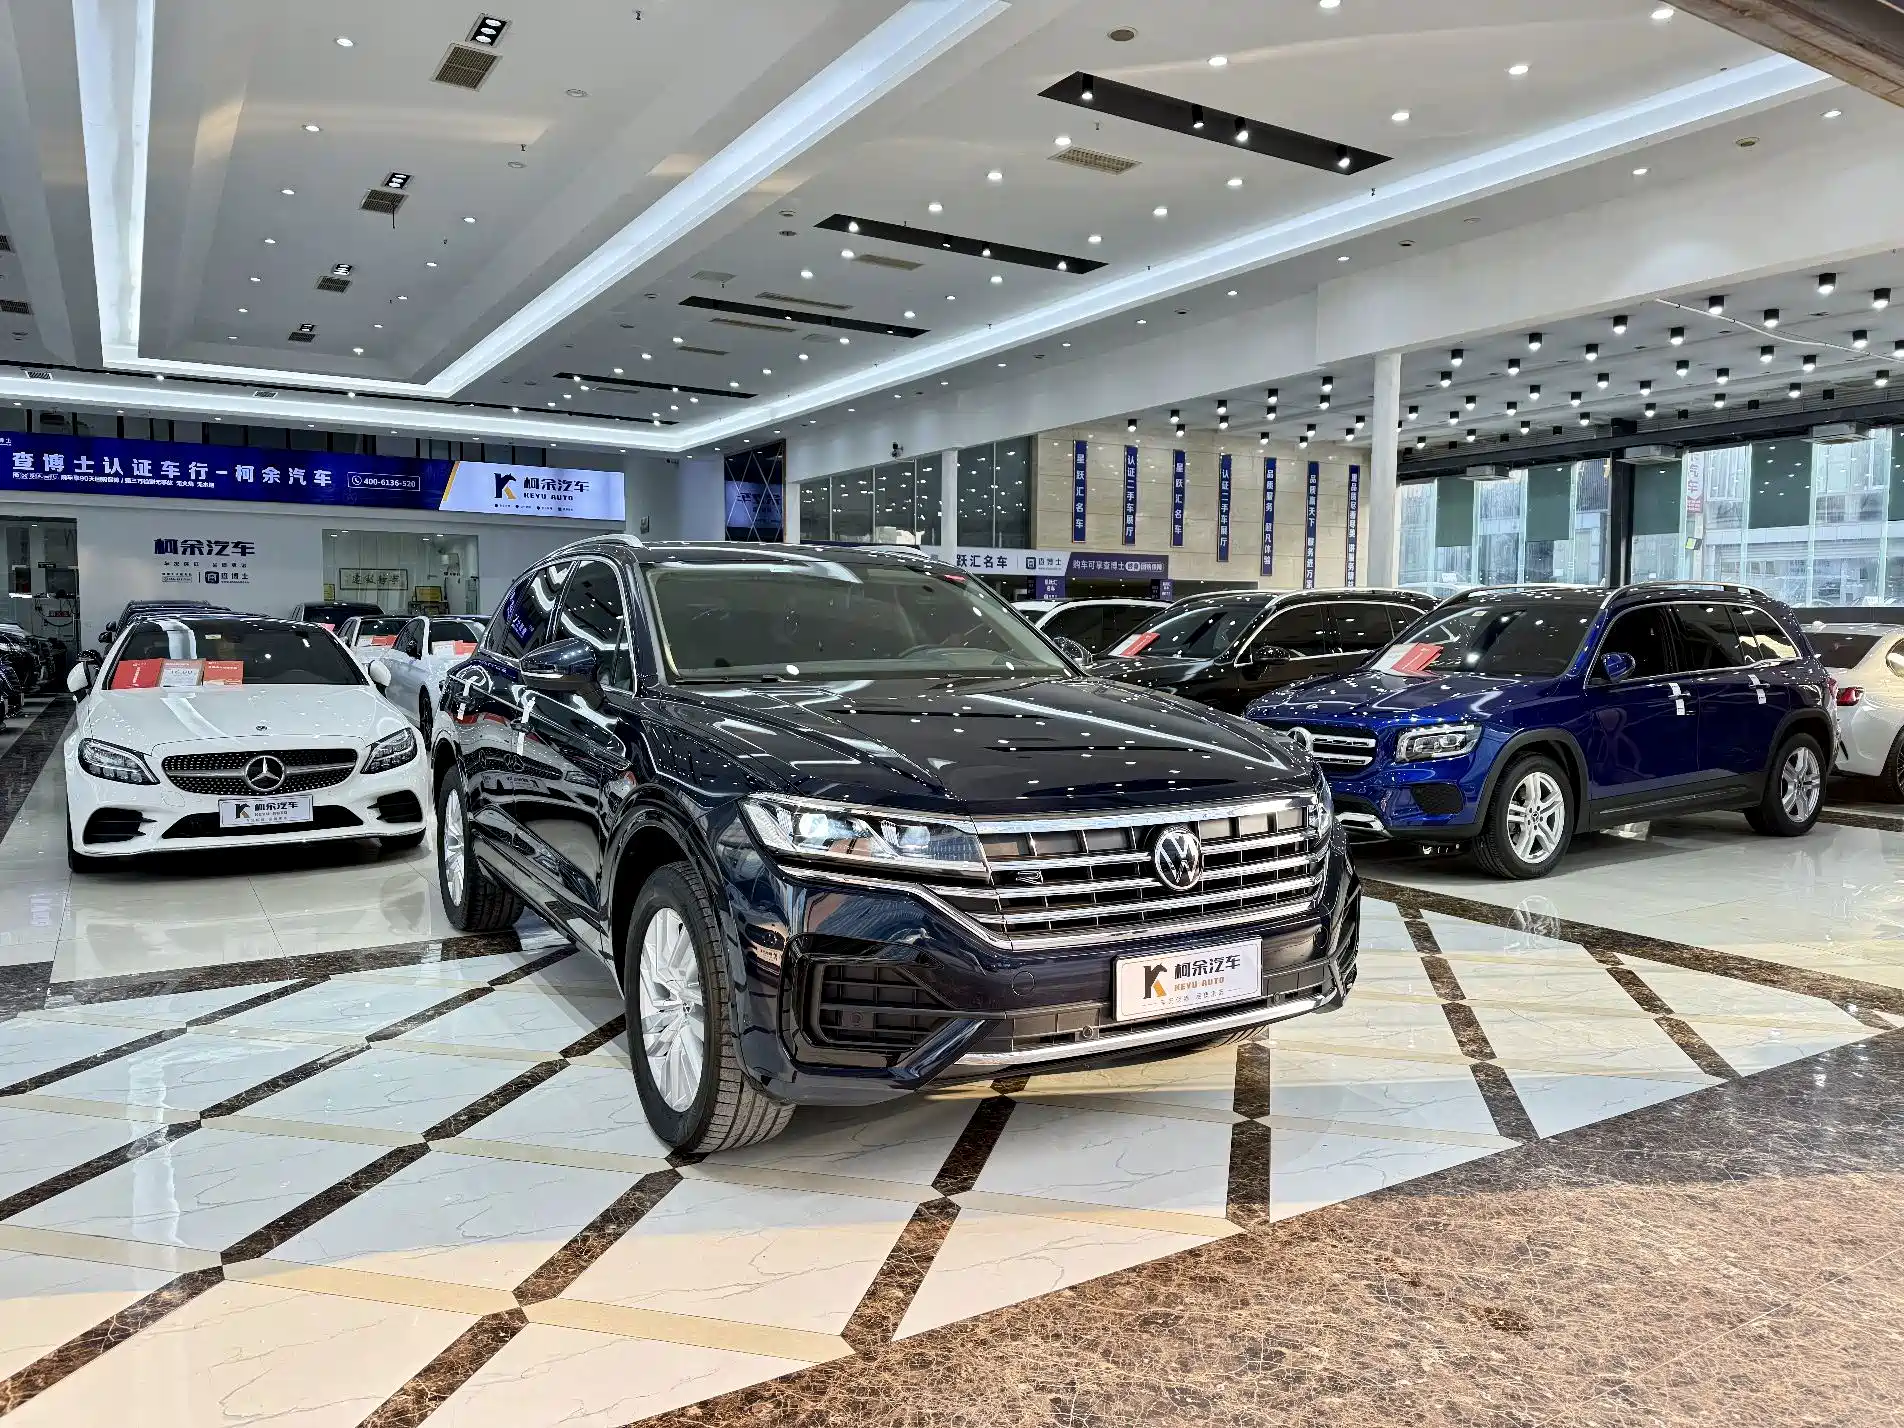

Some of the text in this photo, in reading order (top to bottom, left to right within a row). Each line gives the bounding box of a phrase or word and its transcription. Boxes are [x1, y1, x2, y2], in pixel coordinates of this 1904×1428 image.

[363, 477, 416, 488] 400-6136-520
[523, 476, 590, 493] 柯余汽车
[1075, 453, 1085, 529] 星跃汇名车
[523, 492, 547, 500] KEYU
[1125, 455, 1136, 537] 认证二手车展厅
[1174, 462, 1184, 535] 星跃汇名车
[1219, 469, 1229, 547] 认证二手车展厅
[153, 538, 256, 557] 柯余汽车
[956, 554, 1008, 569] 跃汇名车
[1174, 954, 1241, 980] 柯余汽车
[1174, 976, 1225, 992] KEYU AUTO
